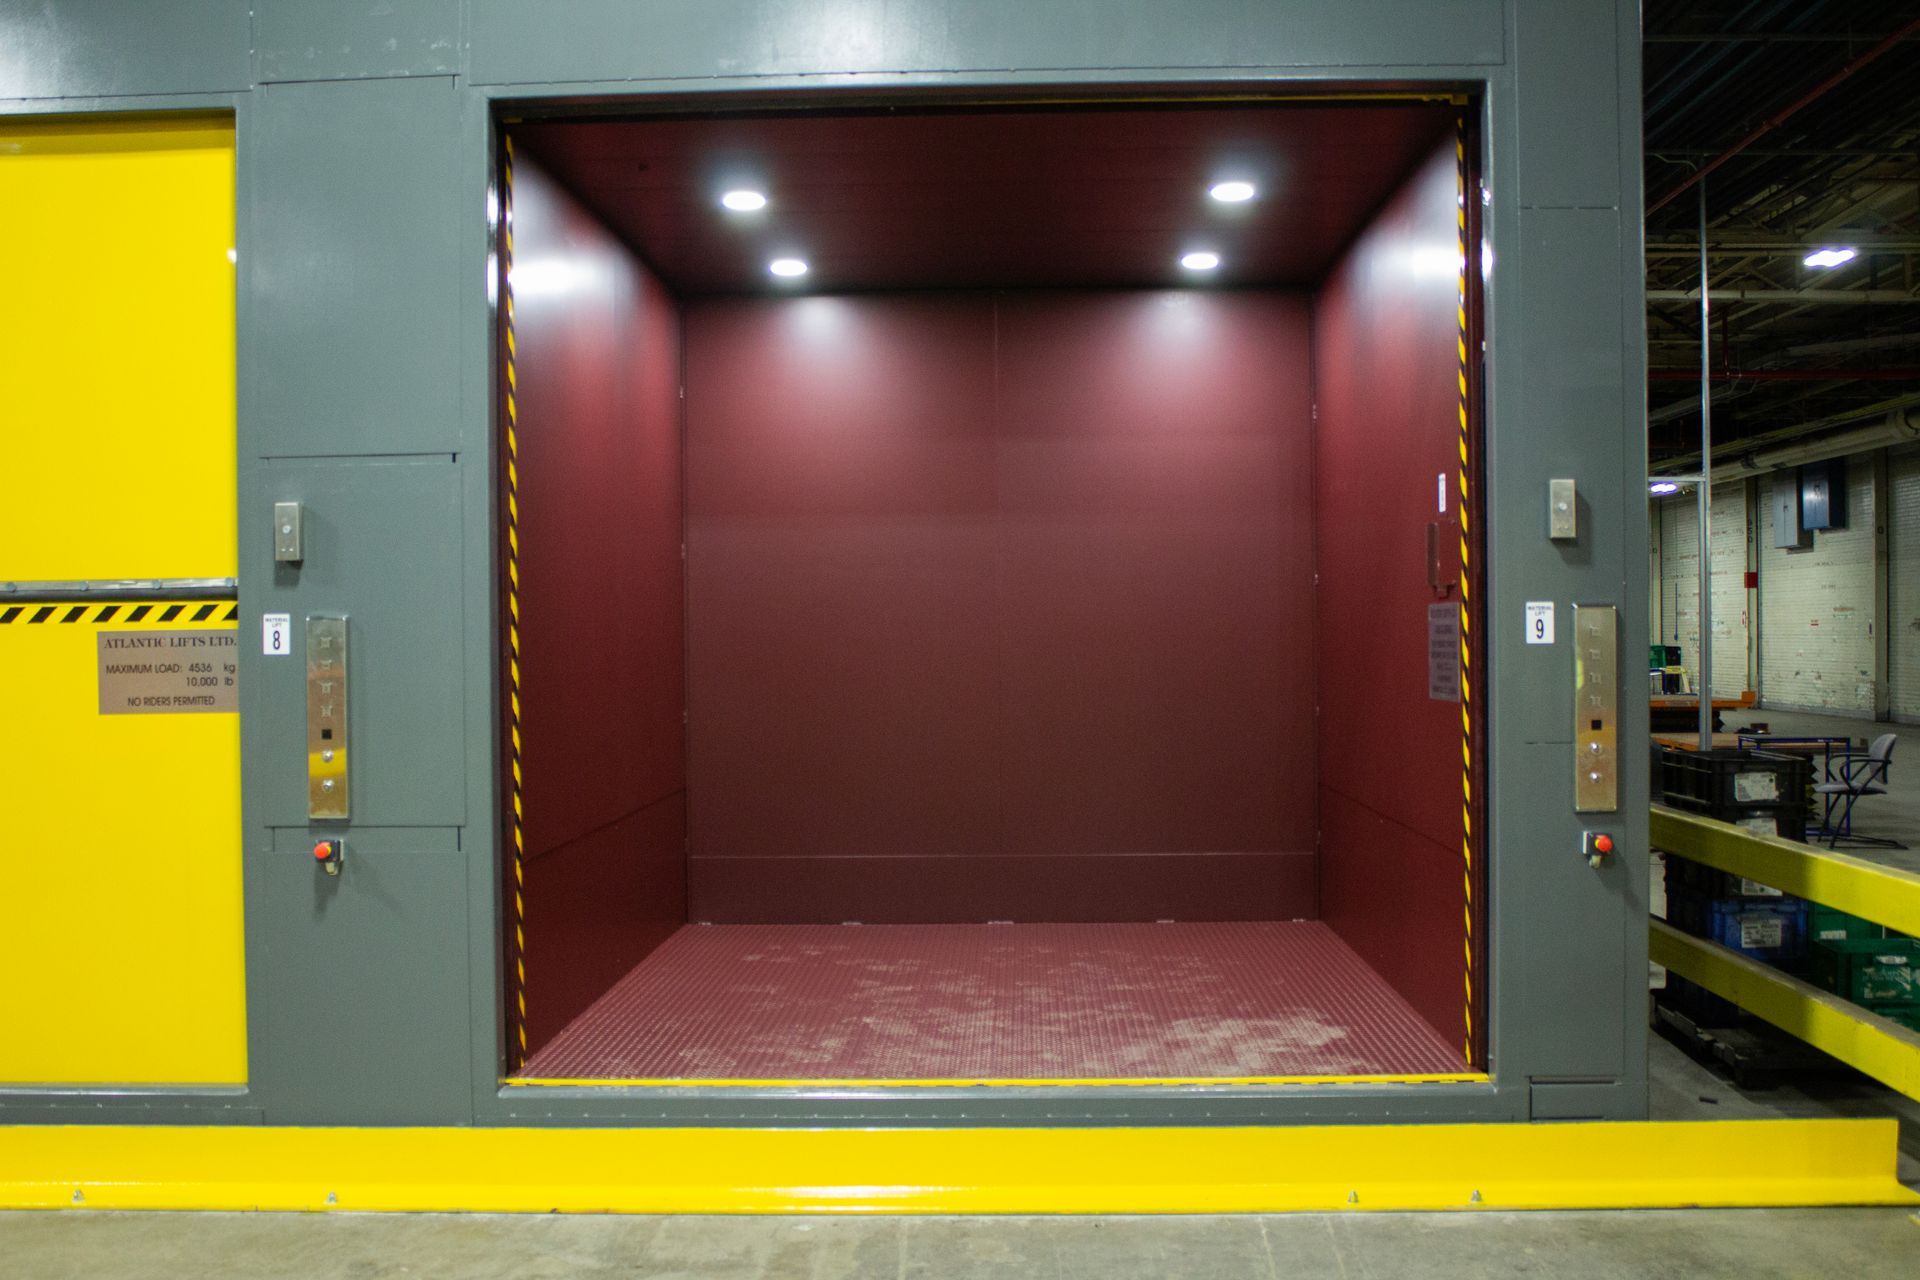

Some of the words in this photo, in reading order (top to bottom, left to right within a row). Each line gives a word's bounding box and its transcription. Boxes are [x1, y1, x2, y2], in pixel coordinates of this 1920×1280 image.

[1535, 618, 1544, 640] 9
[104, 638, 165, 649] ATLANTIC
[170, 637, 206, 648] LIFTS
[209, 636, 237, 647] LTD.
[273, 630, 281, 650] 8
[106, 664, 153, 674] MAXIMUM
[155, 663, 182, 674] LOAD:
[188, 663, 212, 673] 4536
[223, 663, 236, 674] kg
[224, 676, 234, 686] lb
[127, 697, 141, 707] NO
[143, 697, 171, 706] RIDERS
[173, 696, 216, 706] PERMITTED
